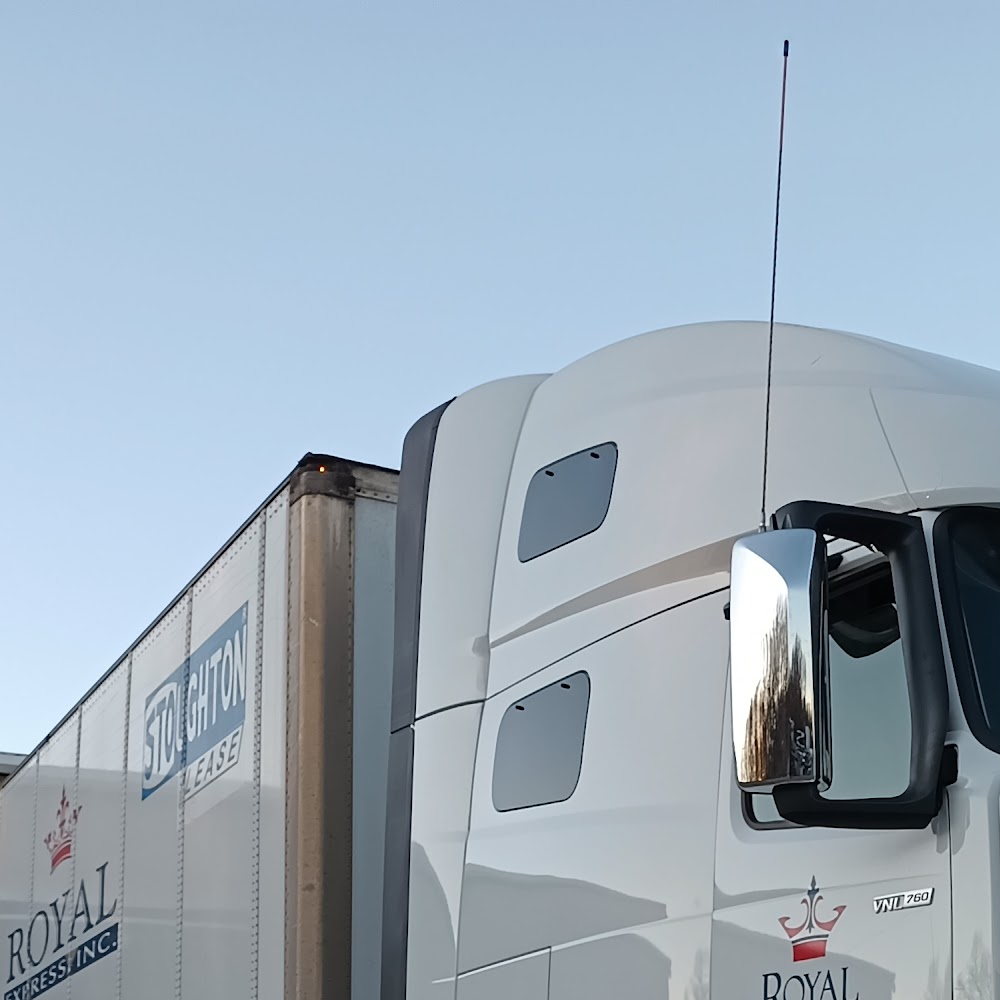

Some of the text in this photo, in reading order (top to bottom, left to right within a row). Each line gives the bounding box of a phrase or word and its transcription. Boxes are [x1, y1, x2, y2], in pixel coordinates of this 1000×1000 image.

[142, 624, 247, 790] STOUGHTON
[184, 731, 240, 797] LEASE
[7, 861, 117, 984] ROYAL
[873, 891, 929, 914] VNL 760
[76, 931, 117, 967] INC.
